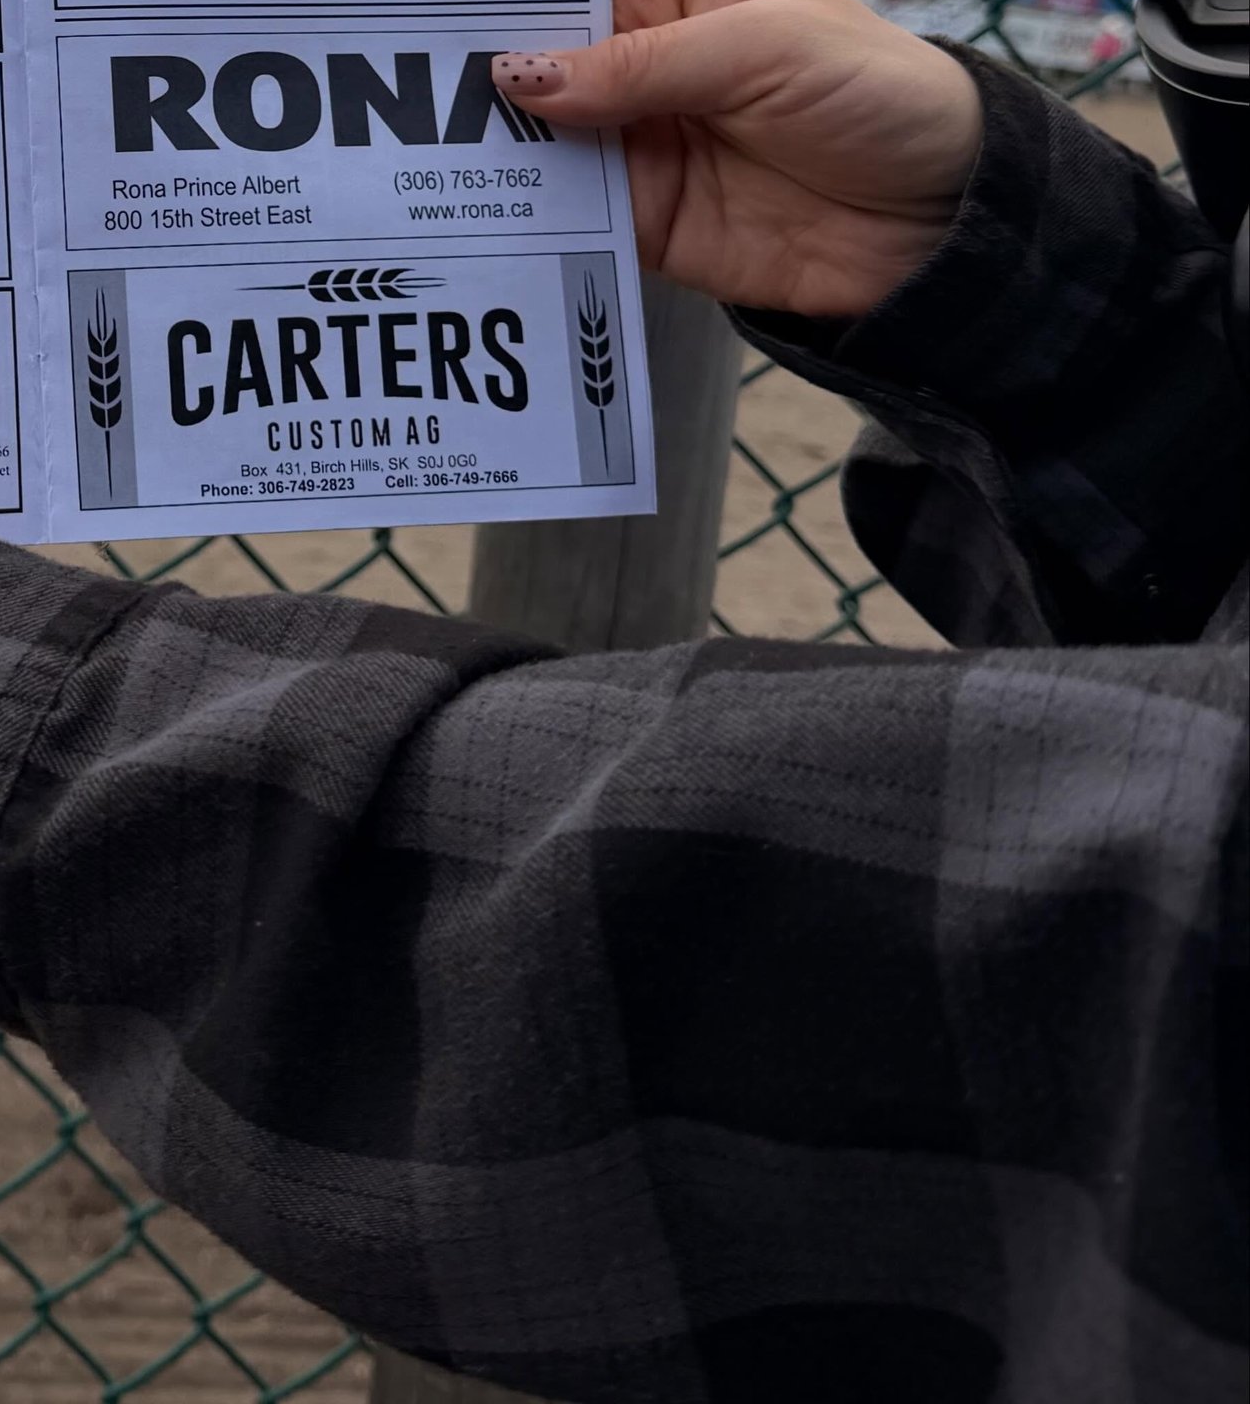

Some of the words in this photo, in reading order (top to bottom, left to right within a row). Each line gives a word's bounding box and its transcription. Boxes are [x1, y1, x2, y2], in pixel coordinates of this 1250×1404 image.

[110, 51, 556, 152] RONA
[113, 180, 166, 199] Rona
[174, 178, 236, 196] Prince
[243, 176, 300, 194] Albert
[395, 171, 444, 195] (306)
[451, 168, 542, 188] 763-7662
[105, 210, 142, 230] 800
[151, 209, 193, 228] 15th
[201, 207, 261, 227] Street
[268, 205, 312, 224] East
[409, 203, 533, 220] www.rona.ca
[167, 308, 529, 426] CARTERS
[268, 418, 390, 451] CUSTOM
[407, 415, 439, 445] AG
[241, 465, 267, 477] Box
[276, 462, 306, 476] 431,
[311, 461, 345, 473] Birch
[351, 459, 383, 472] Hills,
[389, 457, 409, 470] SK
[386, 475, 418, 488] Cell:
[422, 469, 519, 486] 306-749-7666
[201, 484, 252, 496] Phone:
[257, 477, 355, 494] 306-749-2823
